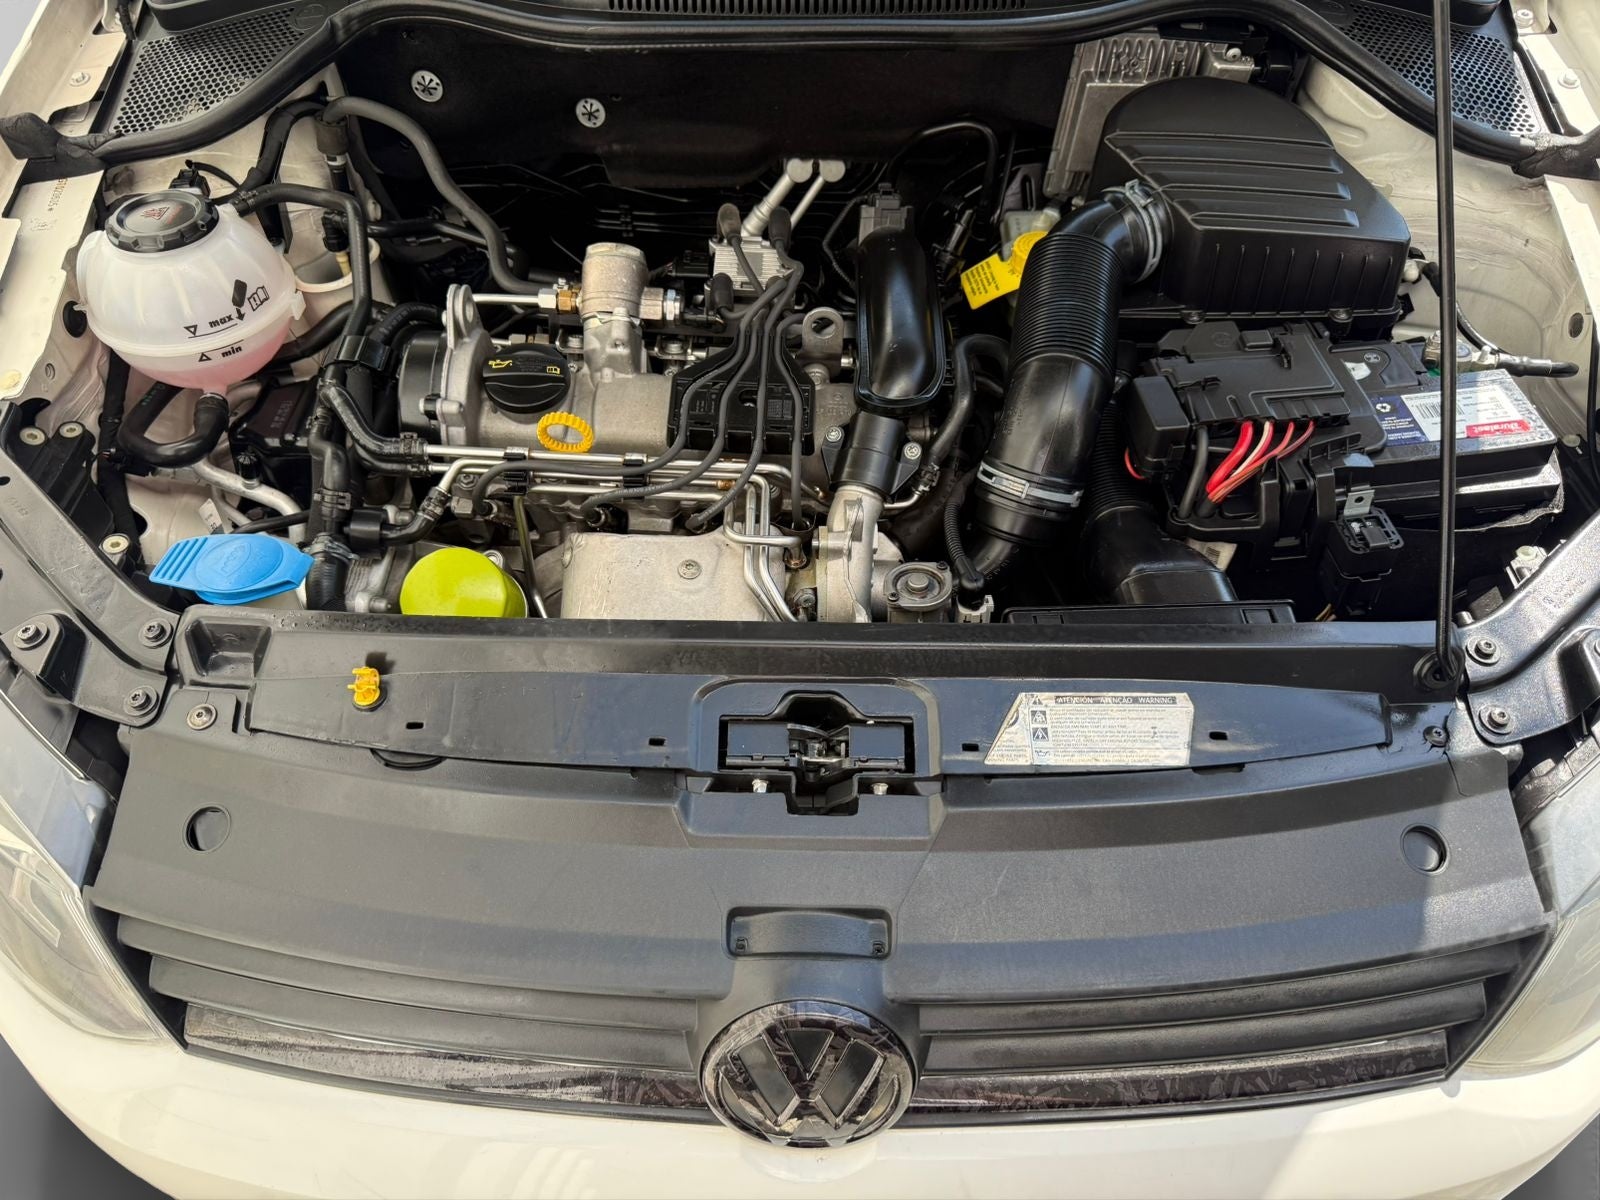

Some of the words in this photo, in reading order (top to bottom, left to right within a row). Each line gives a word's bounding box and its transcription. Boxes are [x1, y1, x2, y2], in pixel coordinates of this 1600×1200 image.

[208, 313, 234, 329] max
[221, 345, 242, 358] min
[1472, 421, 1520, 434] Duralast
[1138, 696, 1174, 705] WARNING
